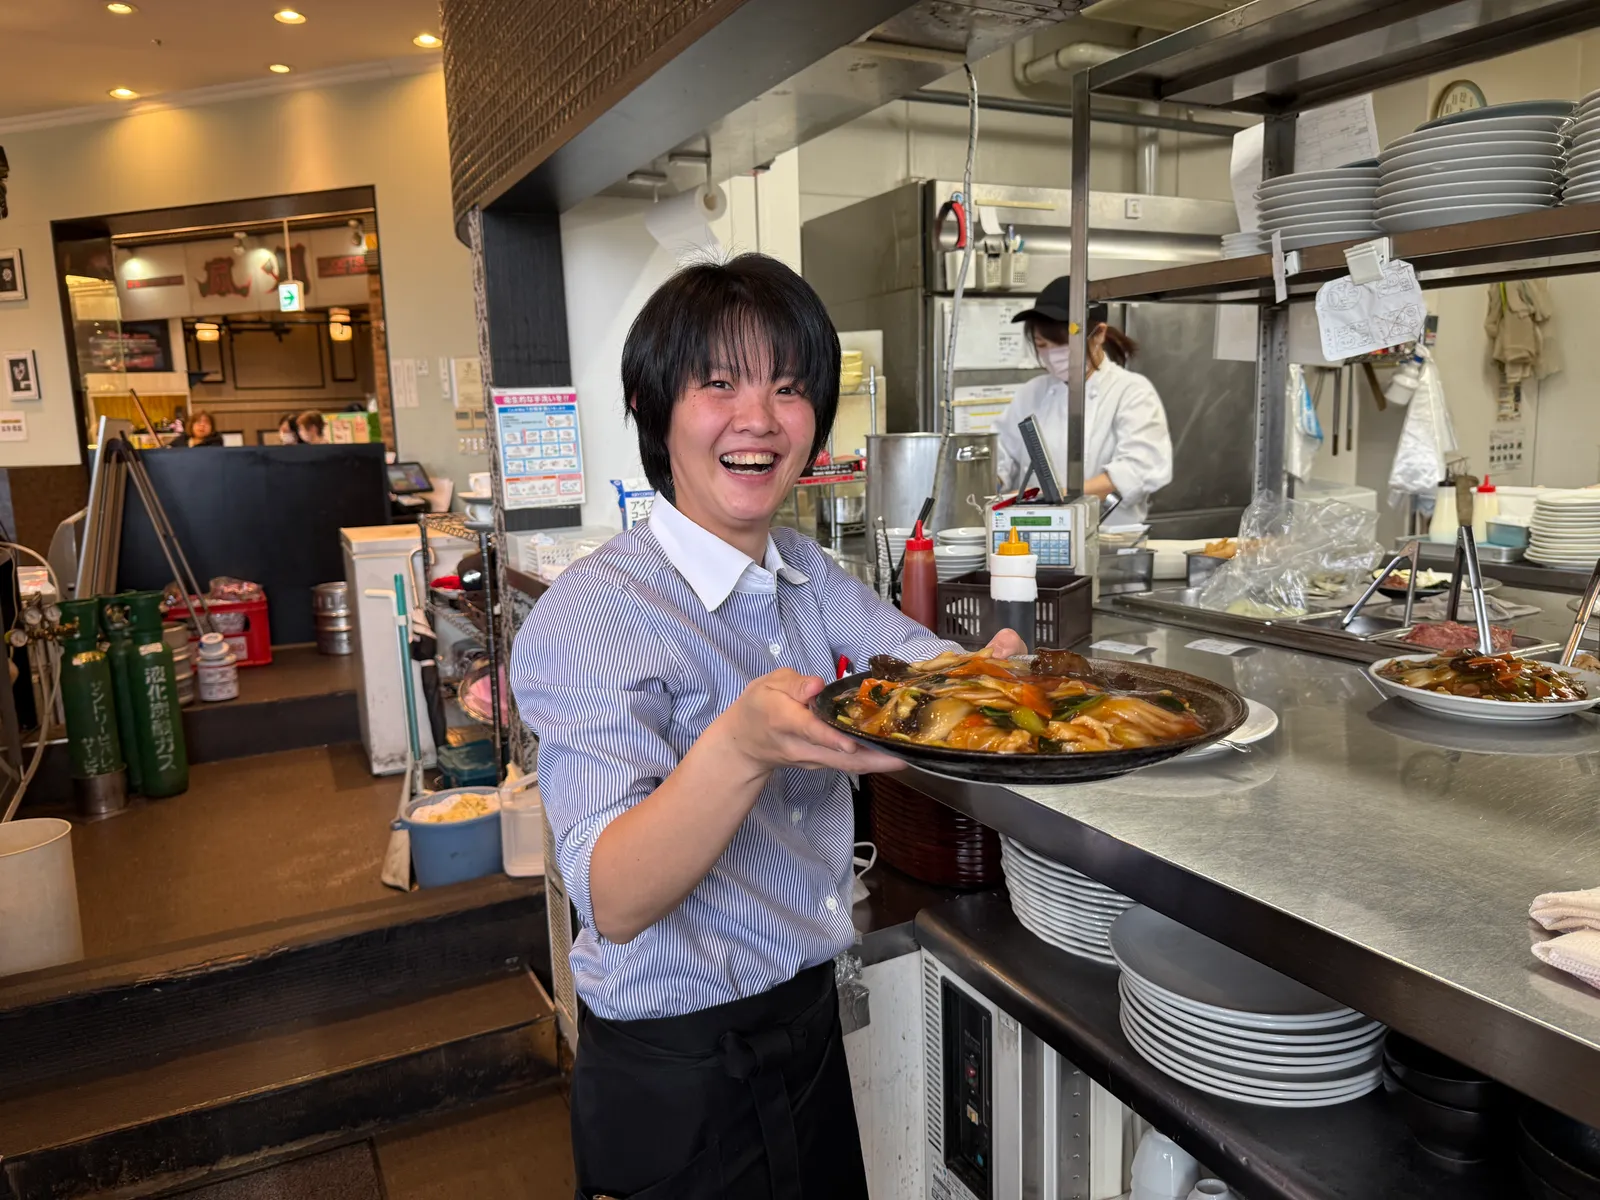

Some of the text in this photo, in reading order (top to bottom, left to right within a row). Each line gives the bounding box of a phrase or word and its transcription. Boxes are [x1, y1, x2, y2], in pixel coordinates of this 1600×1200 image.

[144, 665, 177, 773] 液化炭酸ガス
